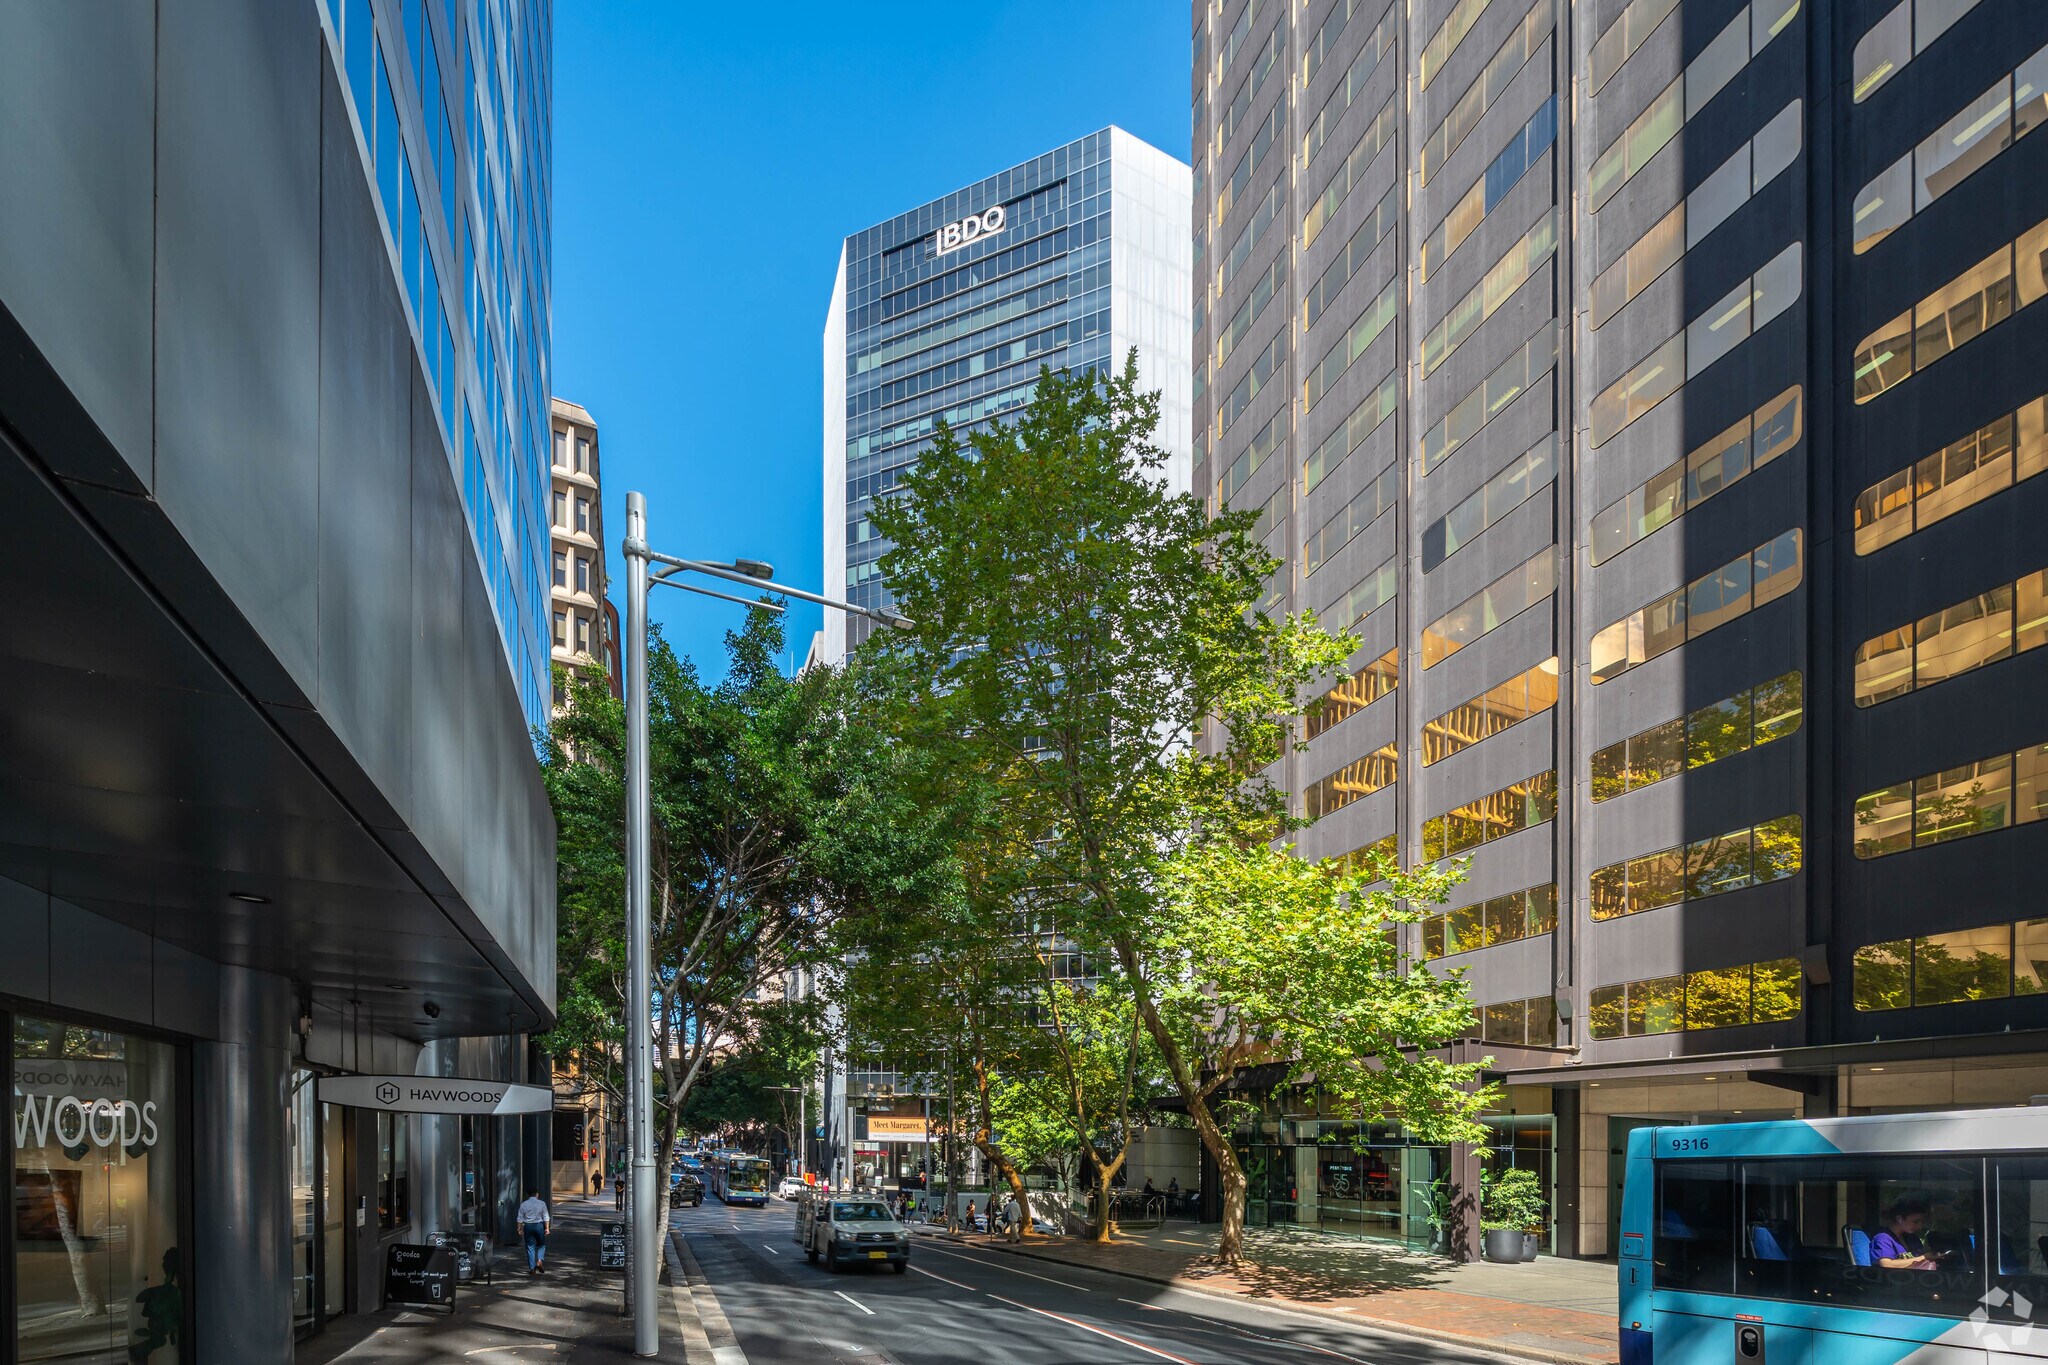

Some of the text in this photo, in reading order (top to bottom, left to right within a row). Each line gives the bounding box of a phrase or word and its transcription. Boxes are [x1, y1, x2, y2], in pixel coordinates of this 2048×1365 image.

[944, 206, 1004, 248] BDO
[410, 1089, 501, 1103] HAVWOODS
[15, 1094, 158, 1149] WOODS
[873, 1121, 888, 1129] Meet
[1672, 1138, 1709, 1151] 9316
[391, 1268, 406, 1276] Where
[407, 1270, 417, 1278] good
